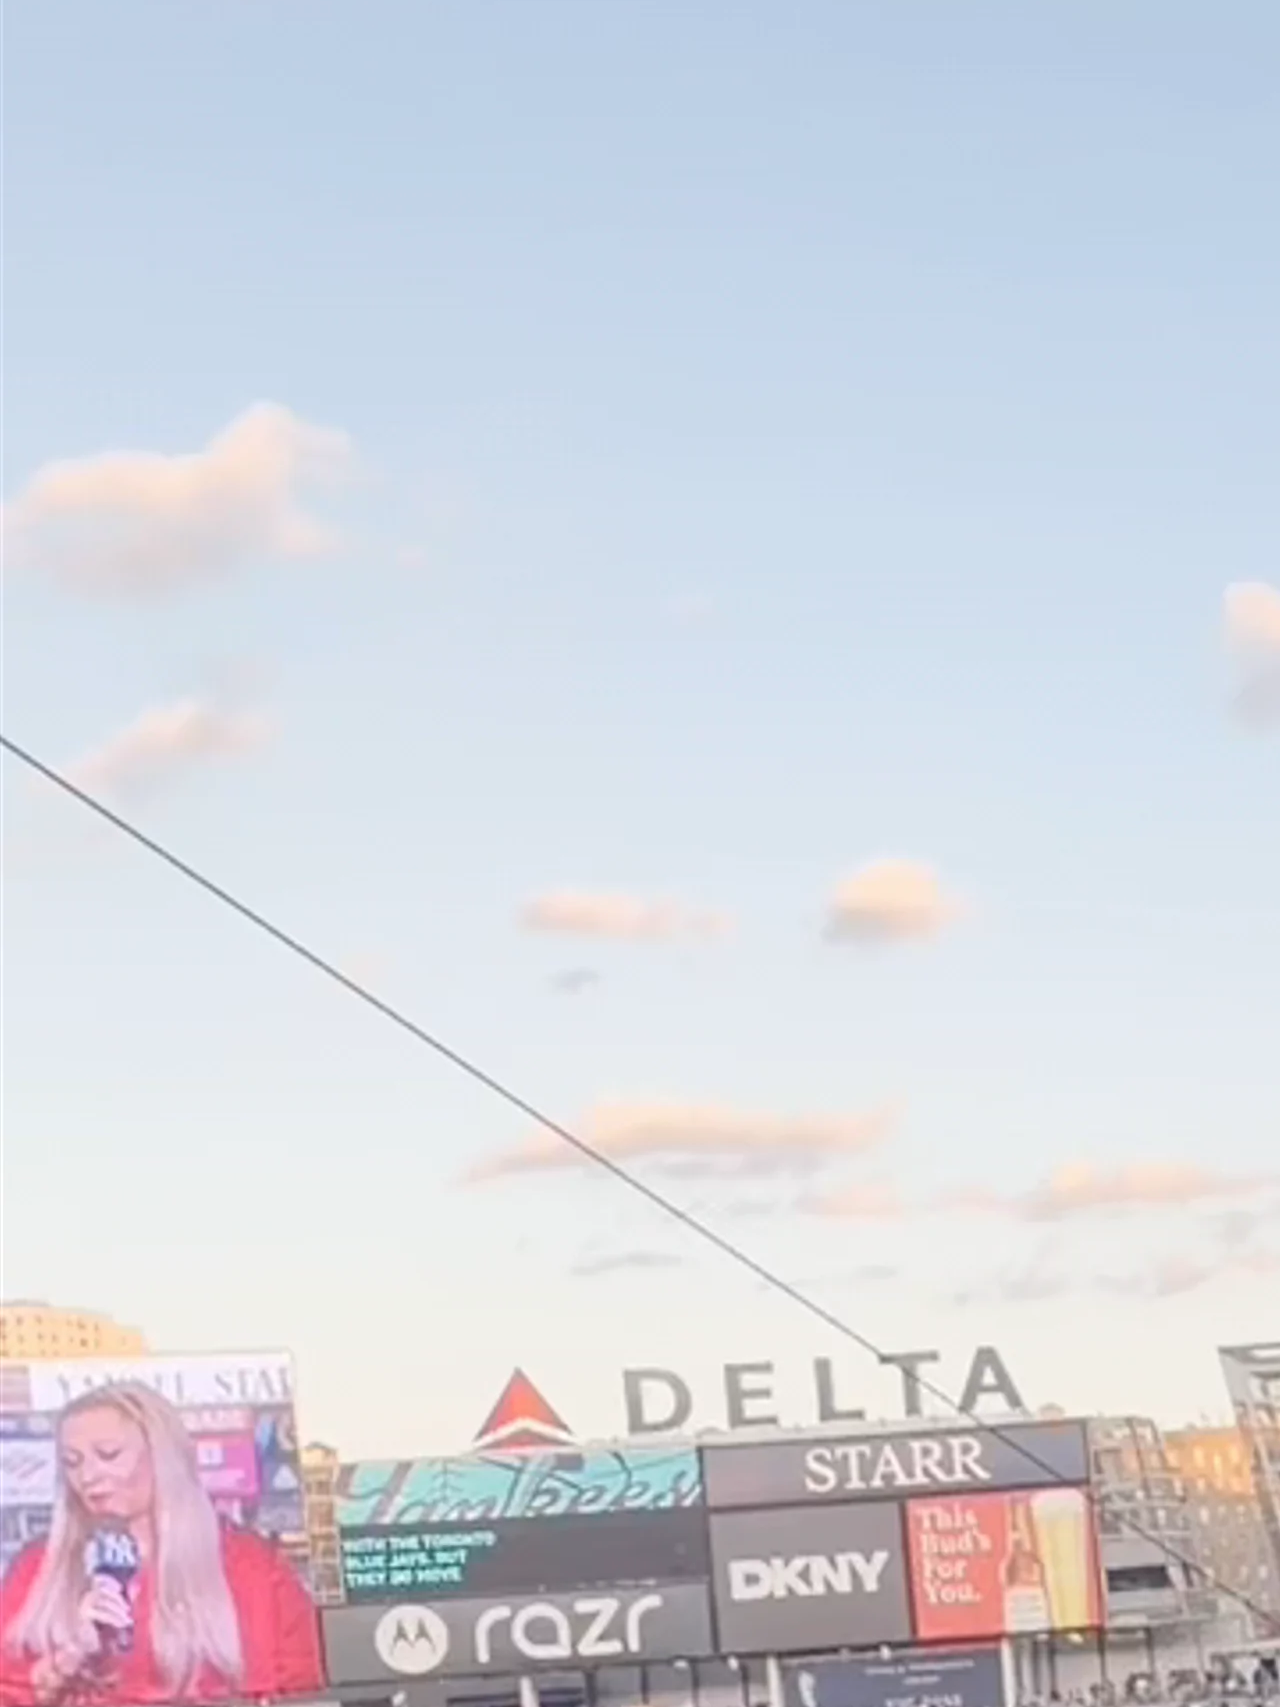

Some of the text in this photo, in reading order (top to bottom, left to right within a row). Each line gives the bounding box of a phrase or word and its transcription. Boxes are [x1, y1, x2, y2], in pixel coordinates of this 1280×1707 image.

[622, 1346, 1029, 1434] DELTA
[804, 1434, 991, 1493] STARR
[915, 1504, 979, 1532] This
[919, 1528, 992, 1555] Bud's
[727, 1550, 888, 1601] DKNY
[922, 1555, 968, 1580] For
[922, 1579, 981, 1605] You.
[475, 1594, 664, 1664] razr
